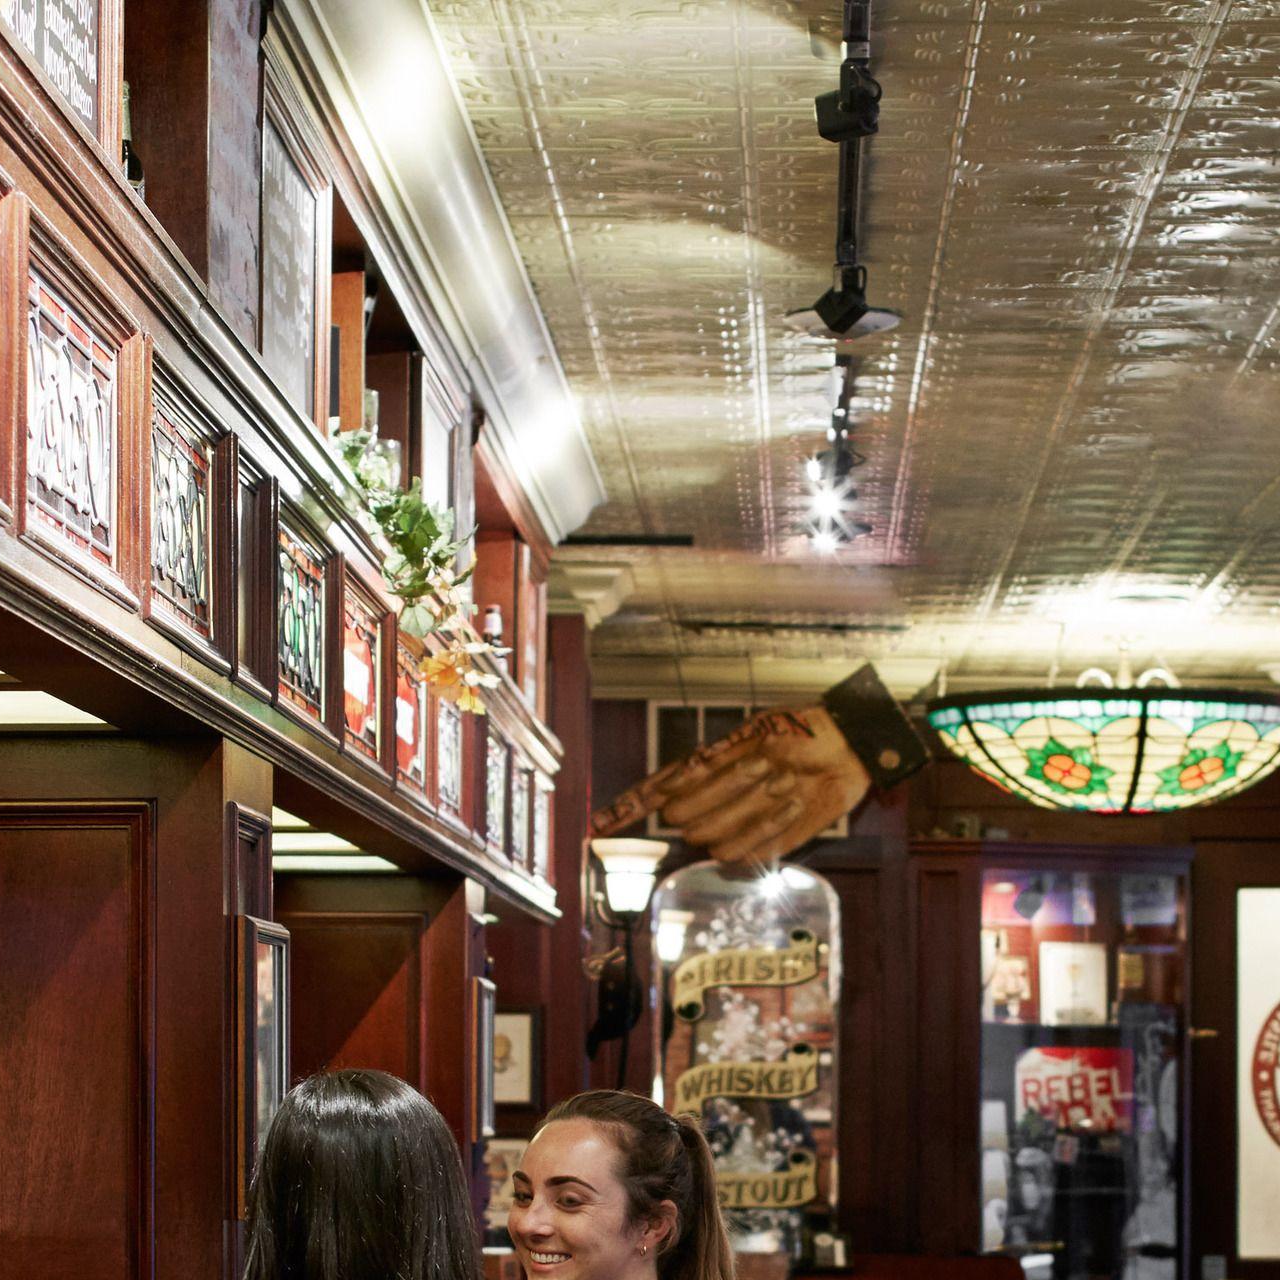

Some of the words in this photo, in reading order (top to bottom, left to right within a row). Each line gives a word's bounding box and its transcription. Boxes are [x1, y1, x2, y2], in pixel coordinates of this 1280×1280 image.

[697, 951, 804, 980] IRISH
[681, 1064, 815, 1101] WHISKEY
[1022, 1067, 1133, 1108] REBEL
[718, 1175, 808, 1204] STOUT
